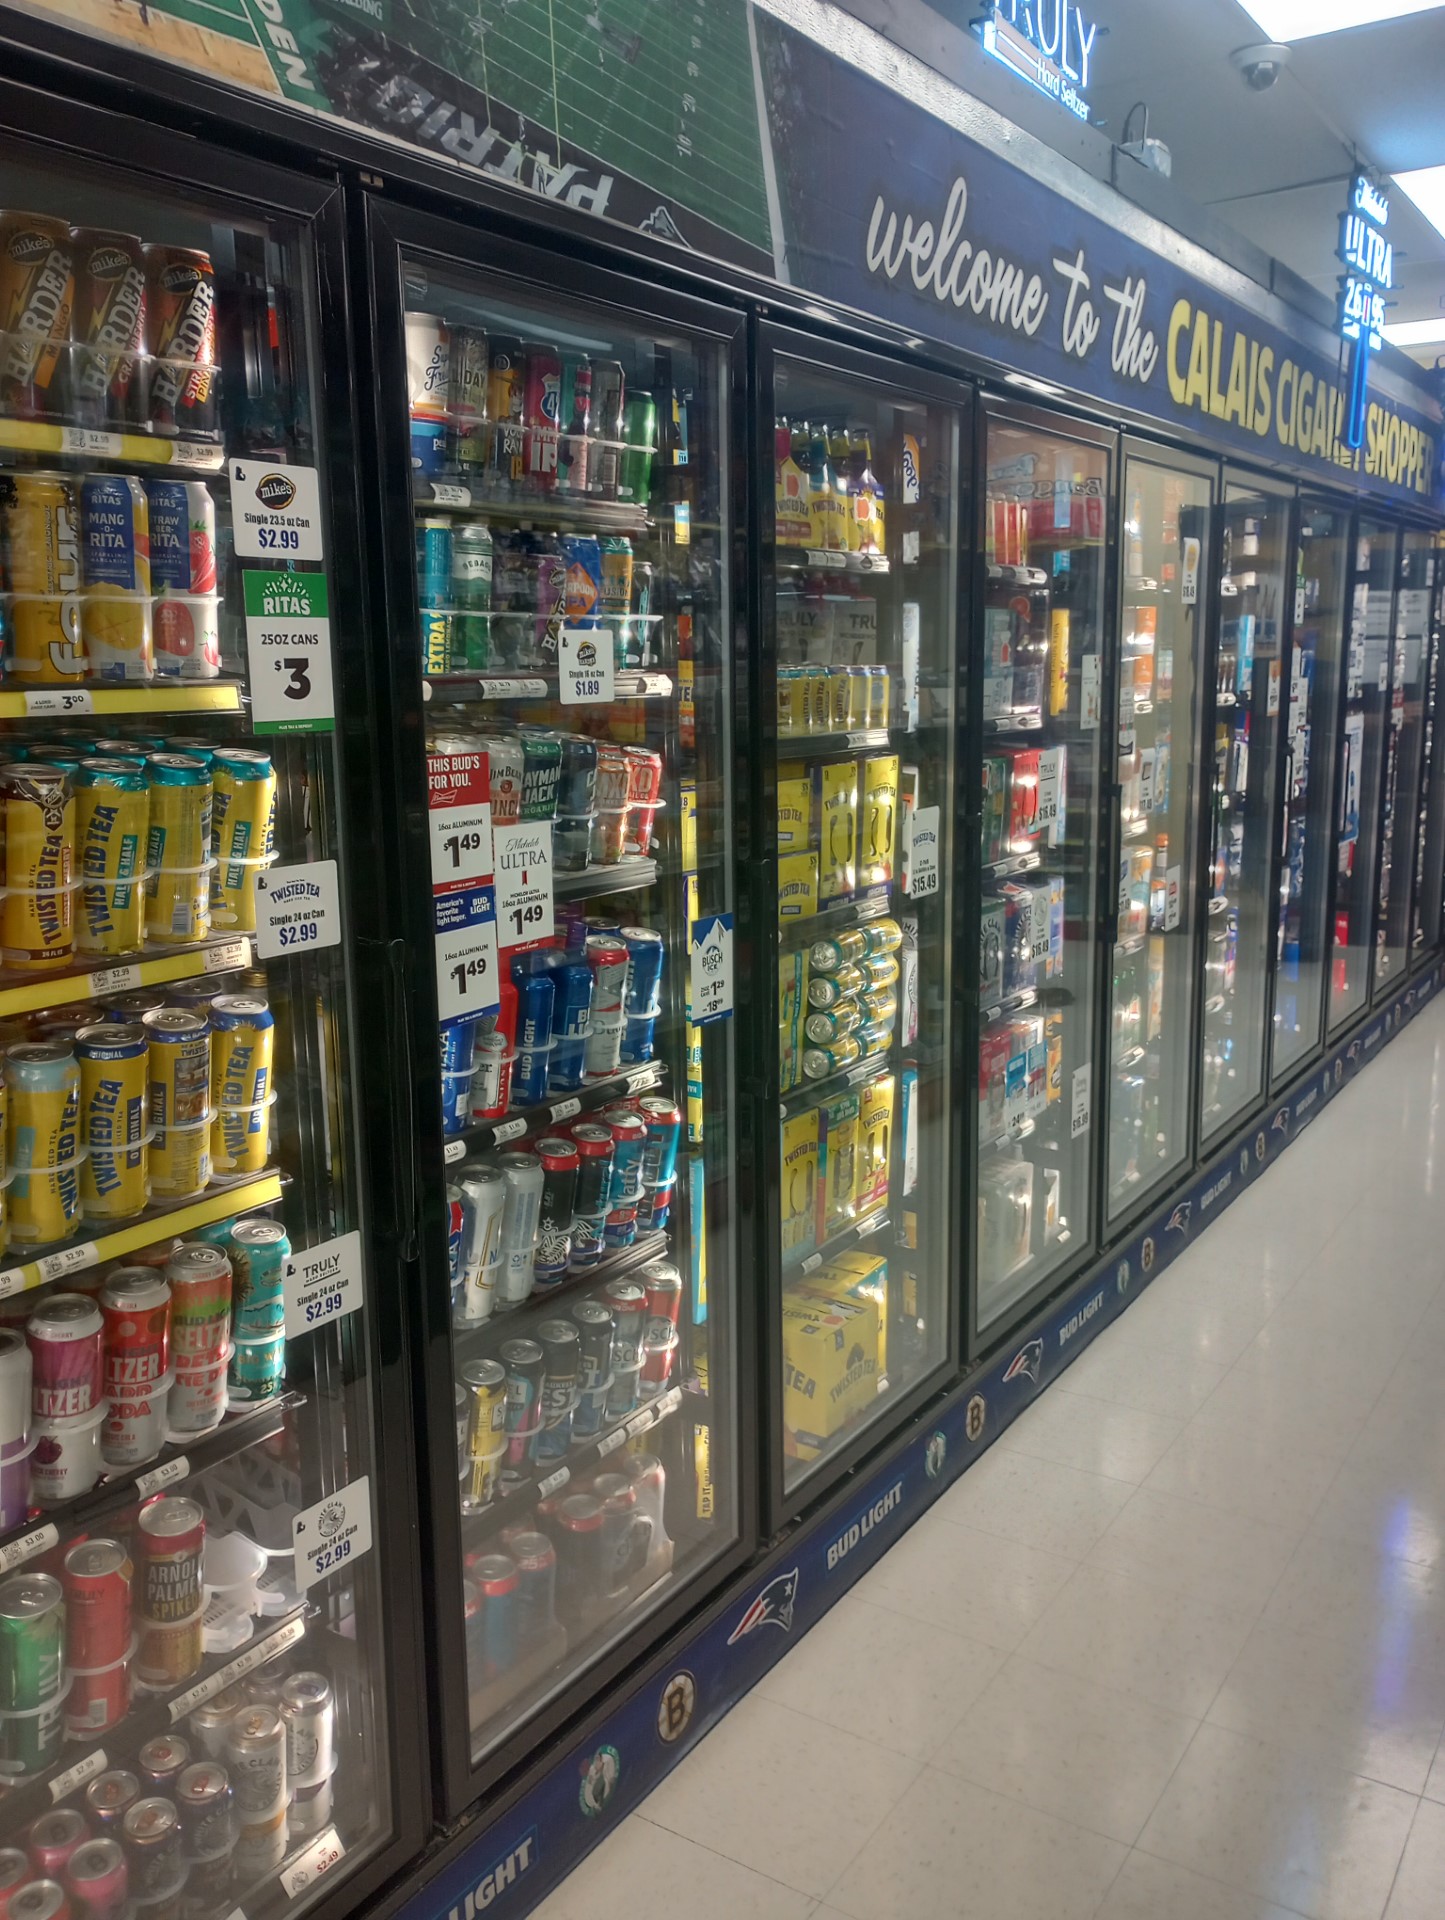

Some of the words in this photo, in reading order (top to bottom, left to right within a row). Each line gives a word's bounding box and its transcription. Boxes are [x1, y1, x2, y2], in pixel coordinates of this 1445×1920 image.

[1036, 57, 1060, 96] Hard
[1061, 80, 1090, 120] Seltzer
[1345, 214, 1392, 289] ULTRA
[163, 270, 200, 288] mike's
[866, 176, 1050, 338] welcome
[1053, 250, 1101, 358] to
[1103, 277, 1160, 384] the
[1167, 298, 1274, 437] CALAIS
[91, 495, 122, 506] RITAS
[260, 481, 293, 499] mike's
[89, 512, 125, 526] MANG
[151, 515, 180, 526] TRAW
[244, 513, 269, 526] Single
[269, 514, 286, 526] 23.5
[287, 517, 295, 527] oz
[296, 516, 310, 529] Can
[90, 532, 126, 548] RITA
[258, 527, 299, 550] $2.99
[263, 597, 311, 615] RITAS
[261, 633, 289, 646] 25OZ
[291, 633, 319, 646] CANS
[428, 620, 447, 674] EXTRA
[274, 657, 312, 701] $3
[569, 670, 584, 679] Single
[576, 680, 599, 696] $1.89
[428, 757, 450, 773] THIS
[451, 755, 480, 772] BUD'S
[428, 774, 448, 790] FOR
[449, 773, 472, 787] YOU.
[523, 765, 561, 787] AYMAN
[521, 783, 554, 804] JACK
[86, 804, 120, 843] TEA
[452, 818, 483, 829] ALUMINUM
[235, 822, 248, 850] HALF
[38, 834, 63, 868] TEA
[121, 837, 134, 866] HALF
[500, 849, 547, 870] ULTRA
[83, 845, 114, 937] TWISTED
[270, 883, 306, 904] TWISTED
[306, 882, 320, 898] TEA
[912, 873, 936, 895] $15.49
[35, 870, 62, 946] TWISTED
[436, 898, 464, 910] America's
[470, 903, 491, 915] LIGHT
[472, 896, 488, 907] BUD
[516, 893, 548, 906] ALUMINUM
[269, 914, 292, 927] Single
[293, 912, 302, 922] 24
[303, 912, 311, 921] oz
[311, 909, 325, 920] Can
[436, 907, 459, 918] favorite
[437, 916, 450, 927] light
[279, 922, 318, 947] $2.99
[458, 944, 489, 957] ALUMINUM
[702, 952, 723, 968] BUSCH
[112, 967, 130, 978] $2.99
[707, 964, 718, 972] ICE
[524, 1018, 536, 1049] IGHT
[225, 1045, 255, 1081] TEA
[521, 1054, 532, 1080] BUD
[90, 1079, 123, 1116] TEA
[220, 1081, 250, 1162] TWISTED
[89, 1115, 122, 1198] TWISTED
[65, 1249, 85, 1261] $2.99
[303, 1253, 340, 1278] TRULY
[297, 1291, 318, 1307] Single
[319, 1286, 328, 1298] 24
[329, 1284, 335, 1293] oz
[336, 1278, 349, 1290] Can
[306, 1293, 342, 1323] $2.99
[1059, 1313, 1078, 1346] BUD
[1077, 1291, 1104, 1329] LIGHT
[784, 1364, 817, 1400] TEA
[826, 1518, 862, 1571] BUD
[860, 1481, 902, 1538] LIGHT
[307, 1541, 329, 1561] Single
[328, 1535, 338, 1549] 24
[337, 1532, 345, 1543] oz
[345, 1524, 358, 1538] Can
[316, 1540, 351, 1574] $2.99
[667, 1686, 687, 1732] B
[316, 1850, 339, 1873] $2.49
